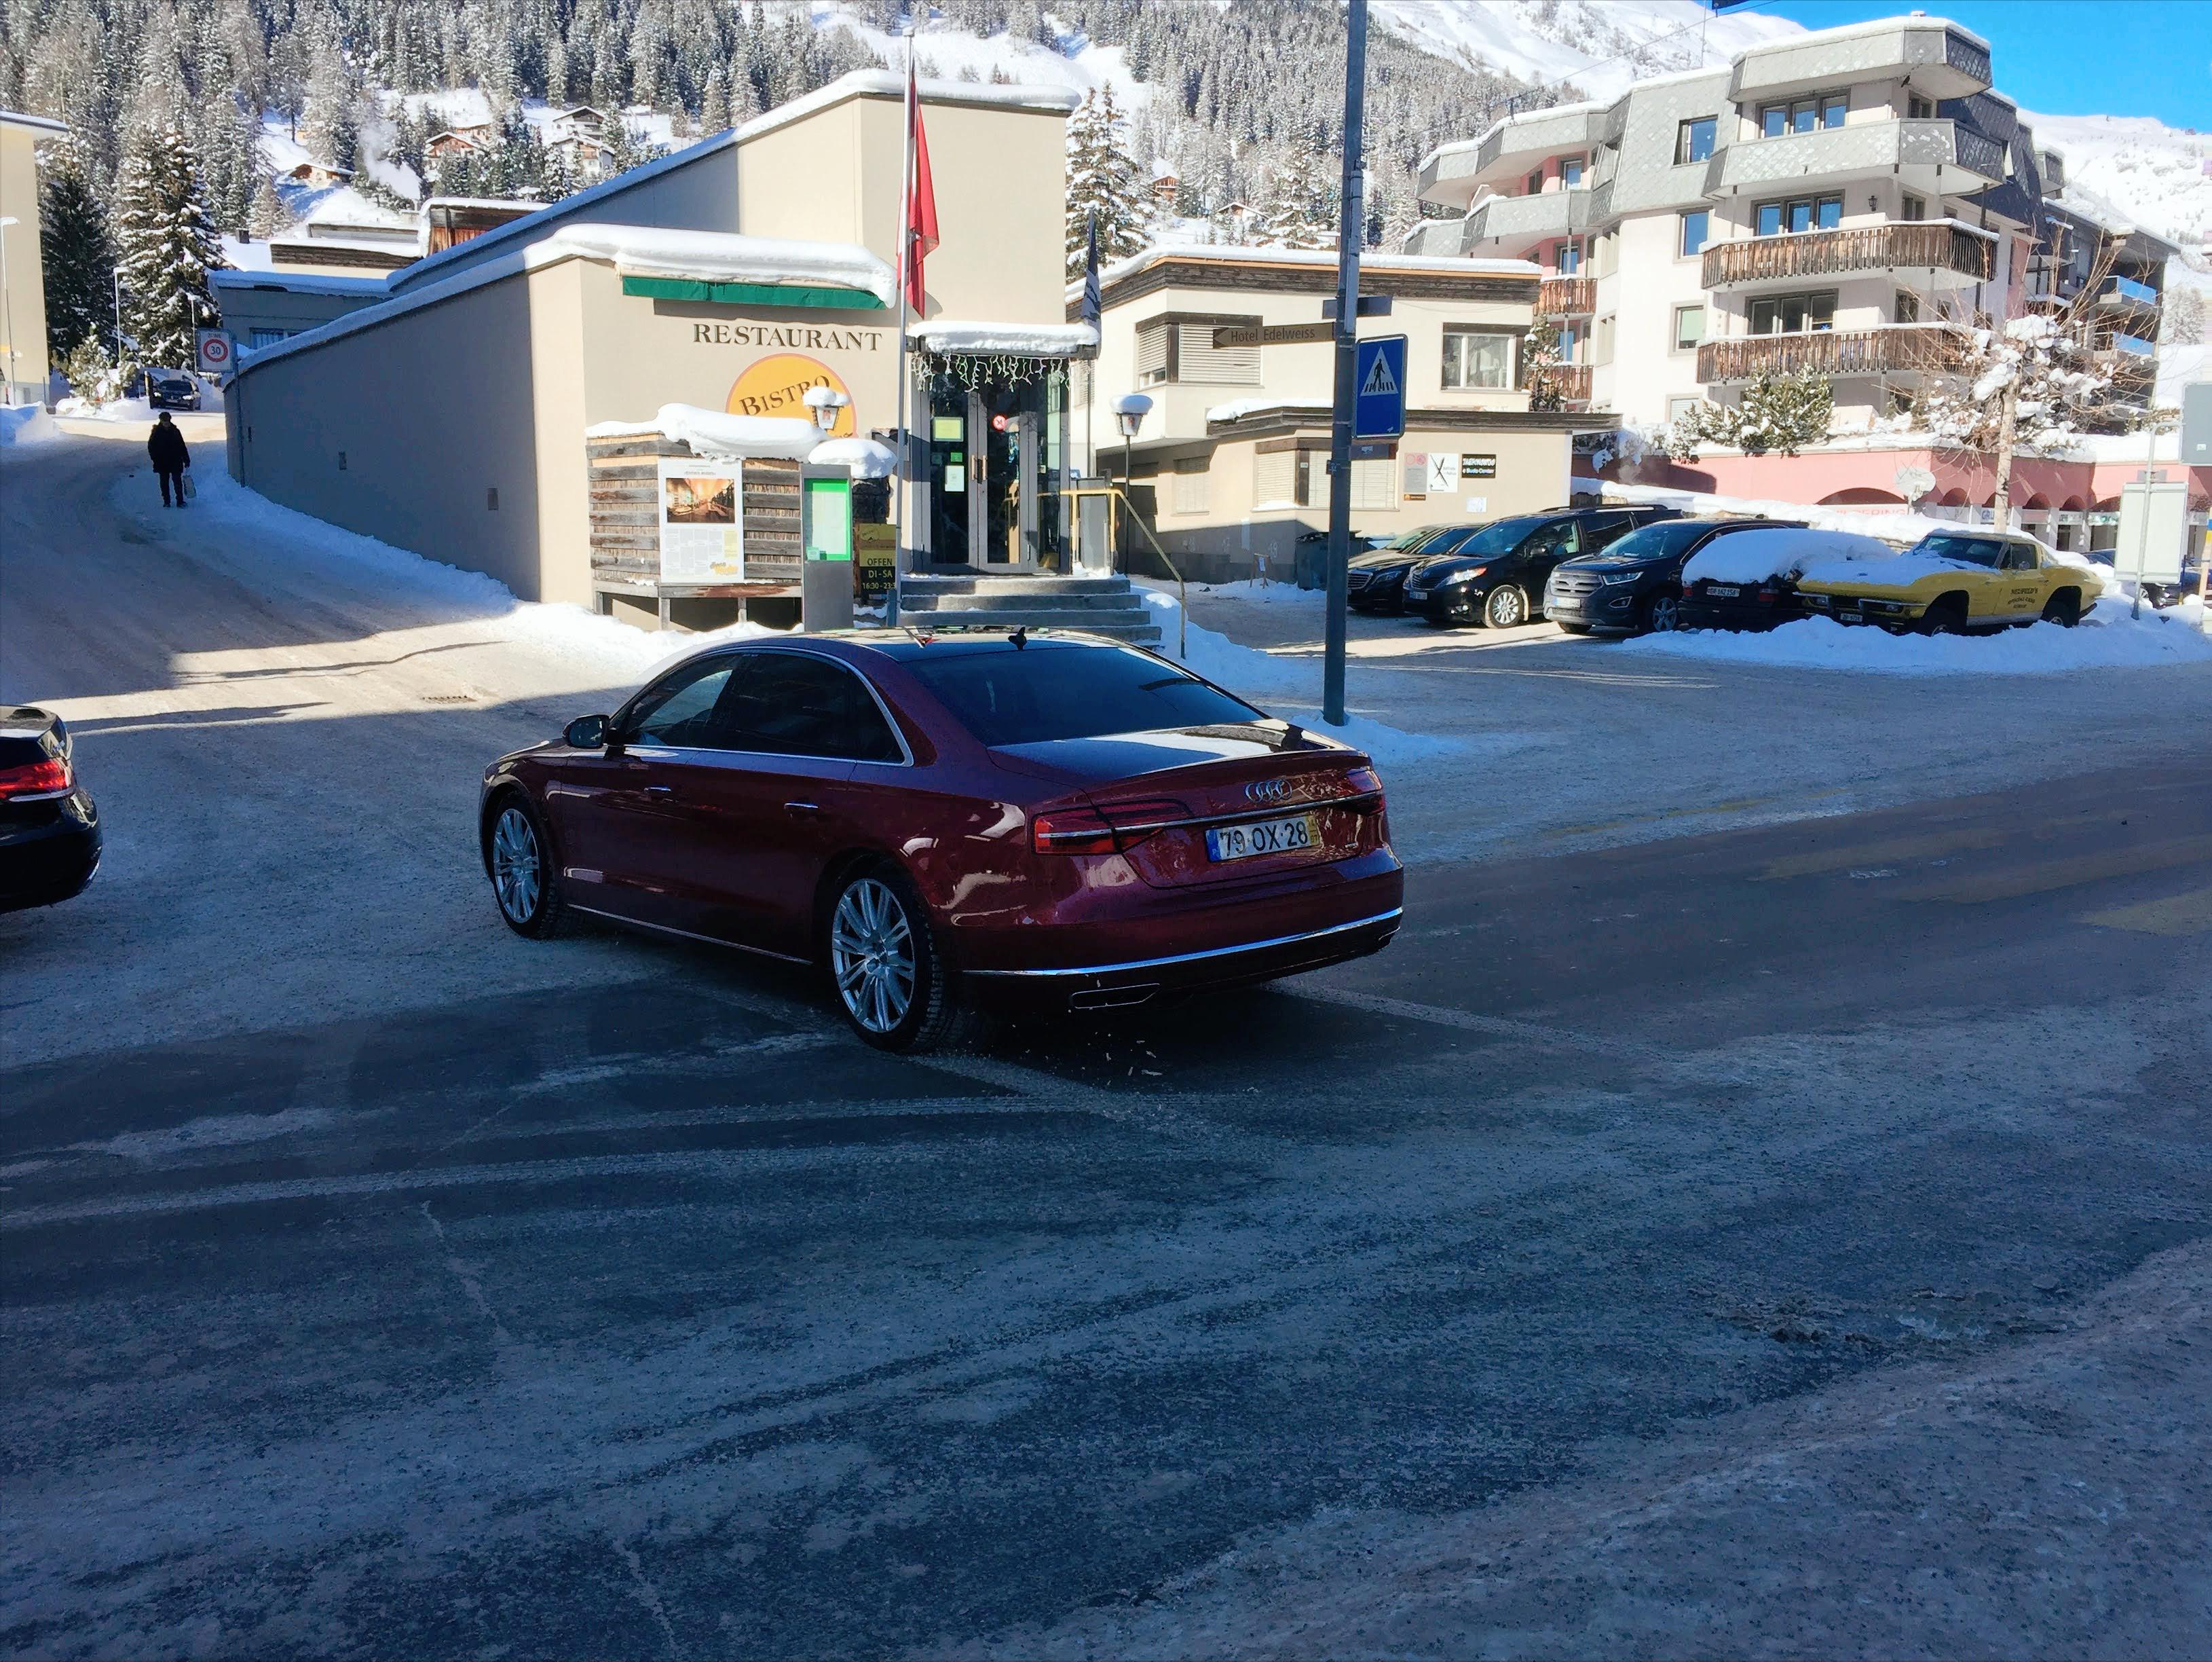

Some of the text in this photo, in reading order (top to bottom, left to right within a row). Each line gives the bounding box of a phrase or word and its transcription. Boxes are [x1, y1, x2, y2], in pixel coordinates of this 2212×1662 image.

[693, 324, 882, 351] RESTAURANT
[1231, 327, 1315, 342] Hotel Edelweiss
[210, 346, 221, 355] 30
[739, 375, 830, 416] BISTRO
[867, 557, 893, 566] OFFEN
